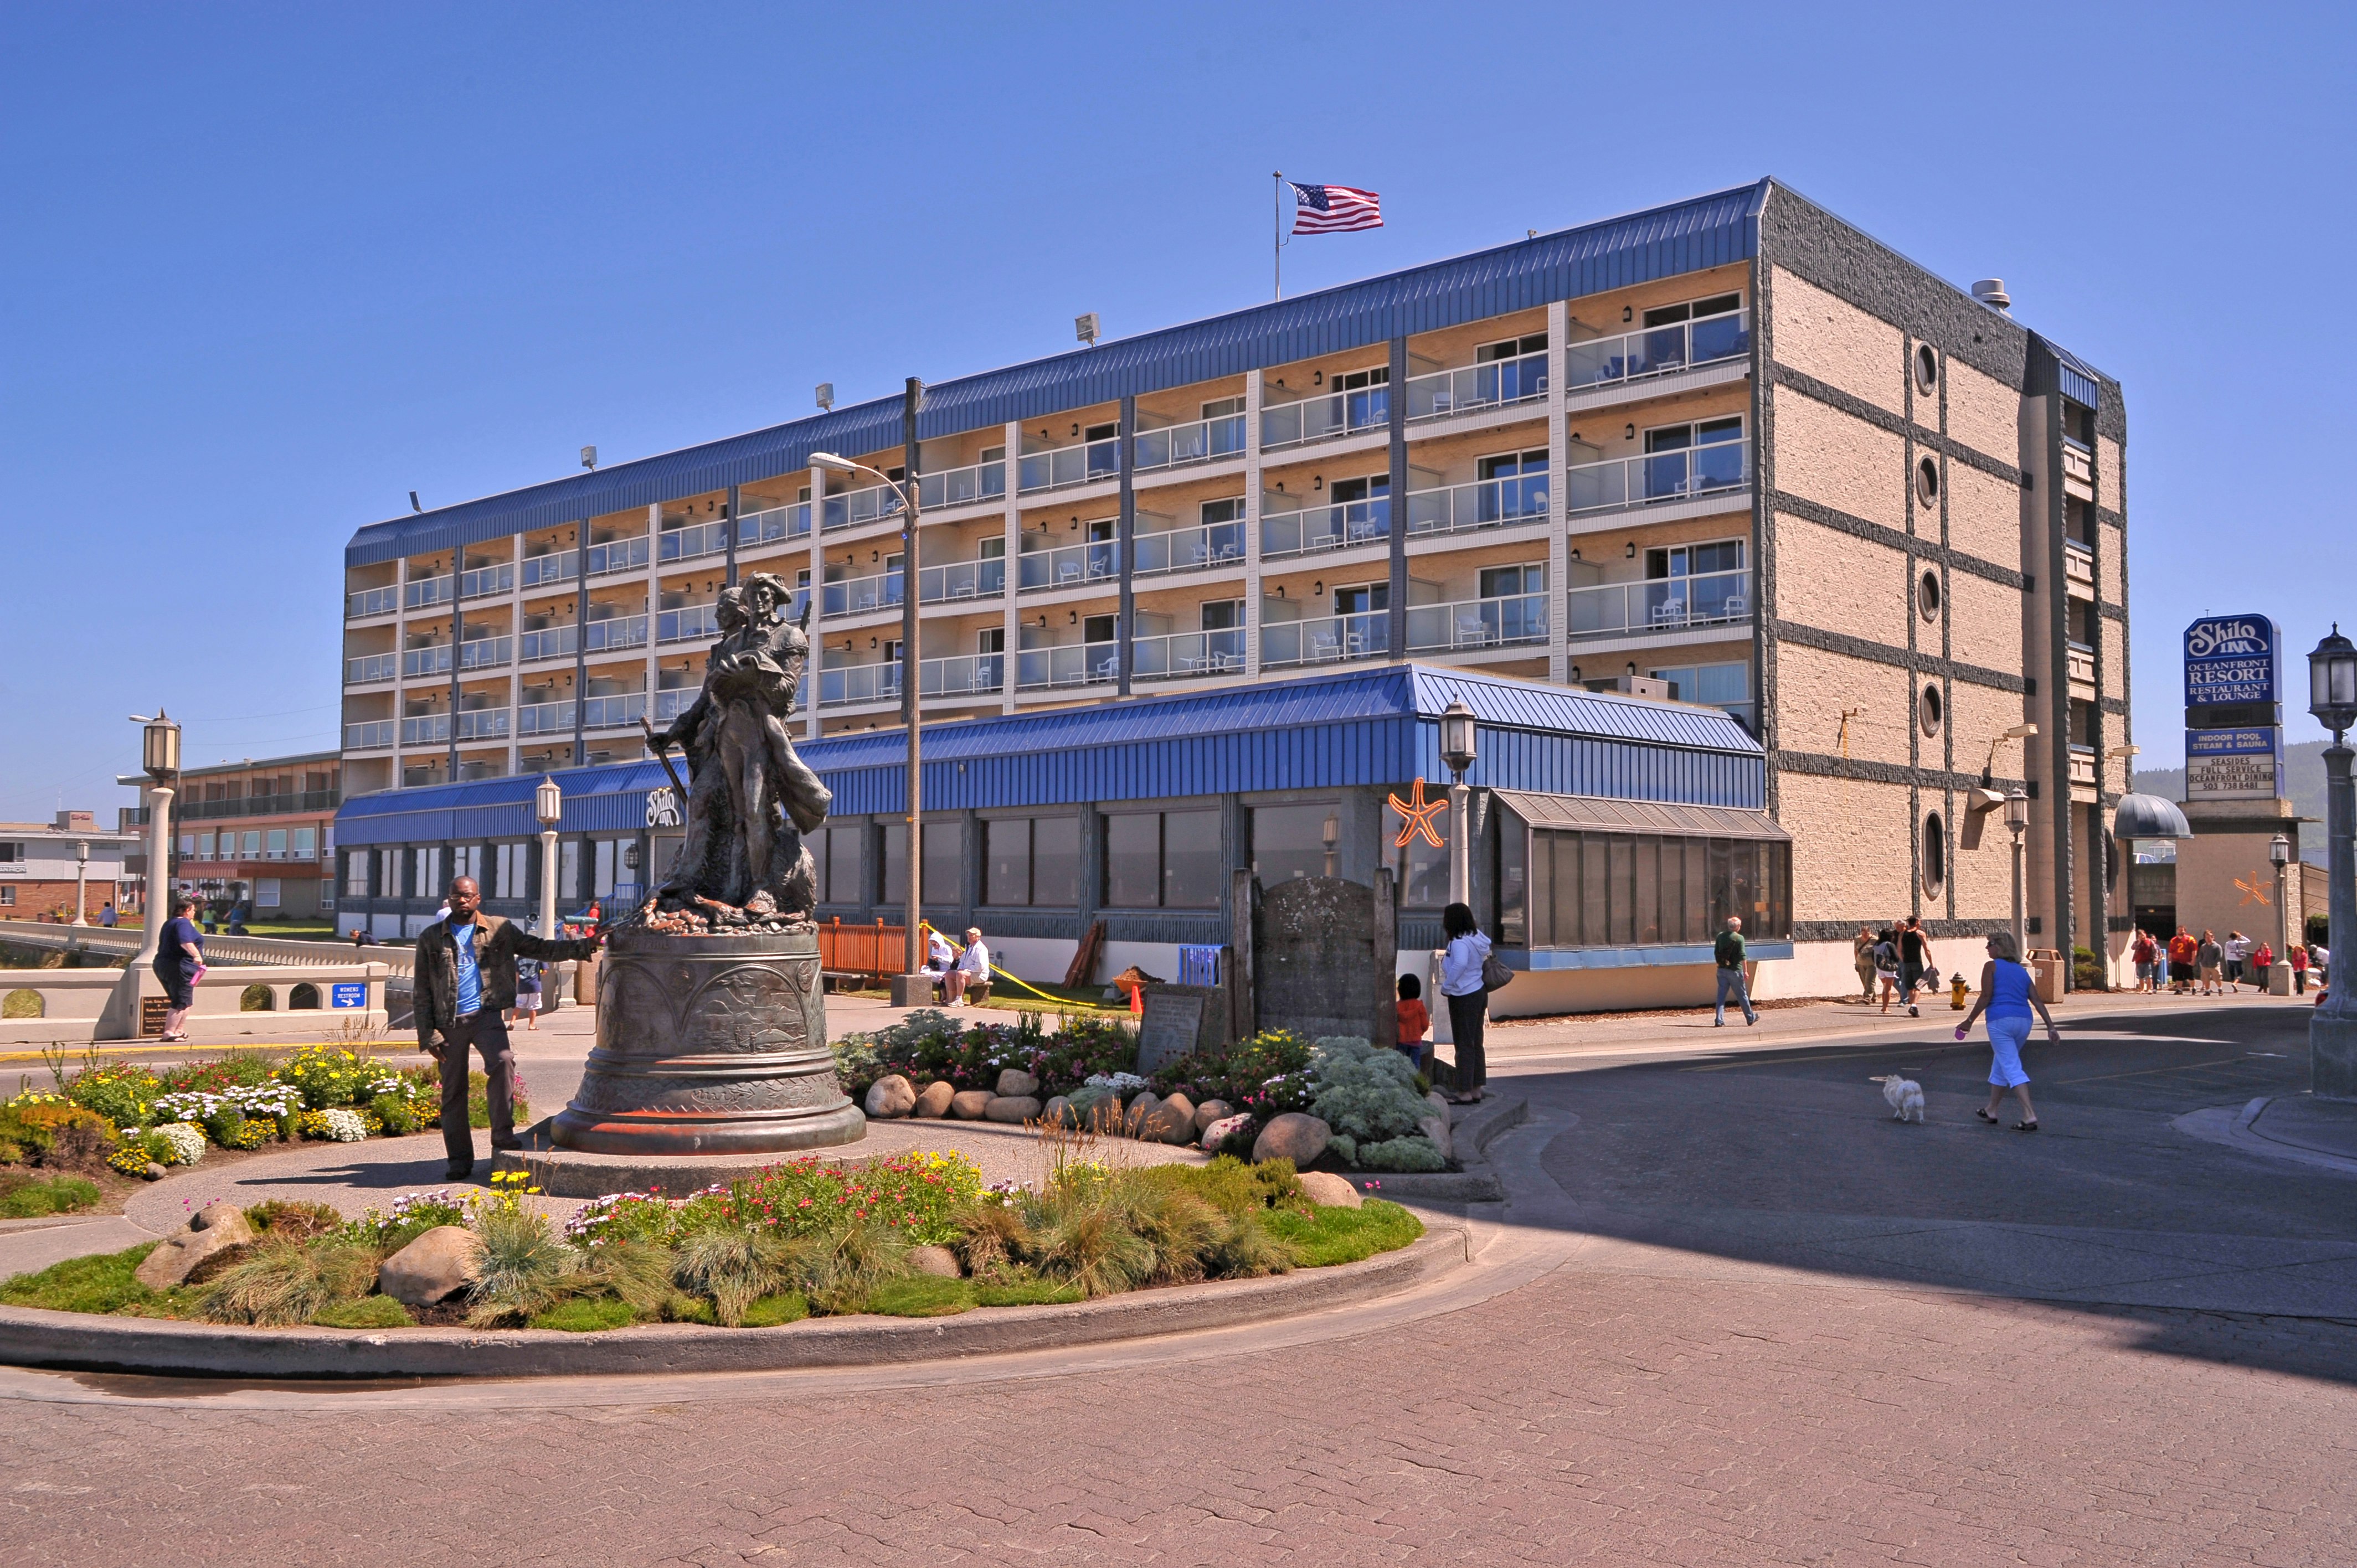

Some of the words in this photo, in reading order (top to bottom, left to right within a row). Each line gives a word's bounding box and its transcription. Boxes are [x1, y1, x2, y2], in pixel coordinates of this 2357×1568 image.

[2188, 621, 2268, 657] Shilo
[2188, 659, 2269, 672] OCEANFRONT
[2189, 667, 2269, 685] RESORT
[2189, 683, 2269, 695] RESTAURANT
[2197, 694, 2208, 703] &
[2212, 691, 2261, 702] LOUNGE
[2211, 757, 2250, 765] SEASIDES
[2189, 774, 2242, 782] OCEANFRONT
[646, 788, 680, 827] Shilo
[2177, 943, 2184, 953] 2
[519, 965, 536, 979] 34
